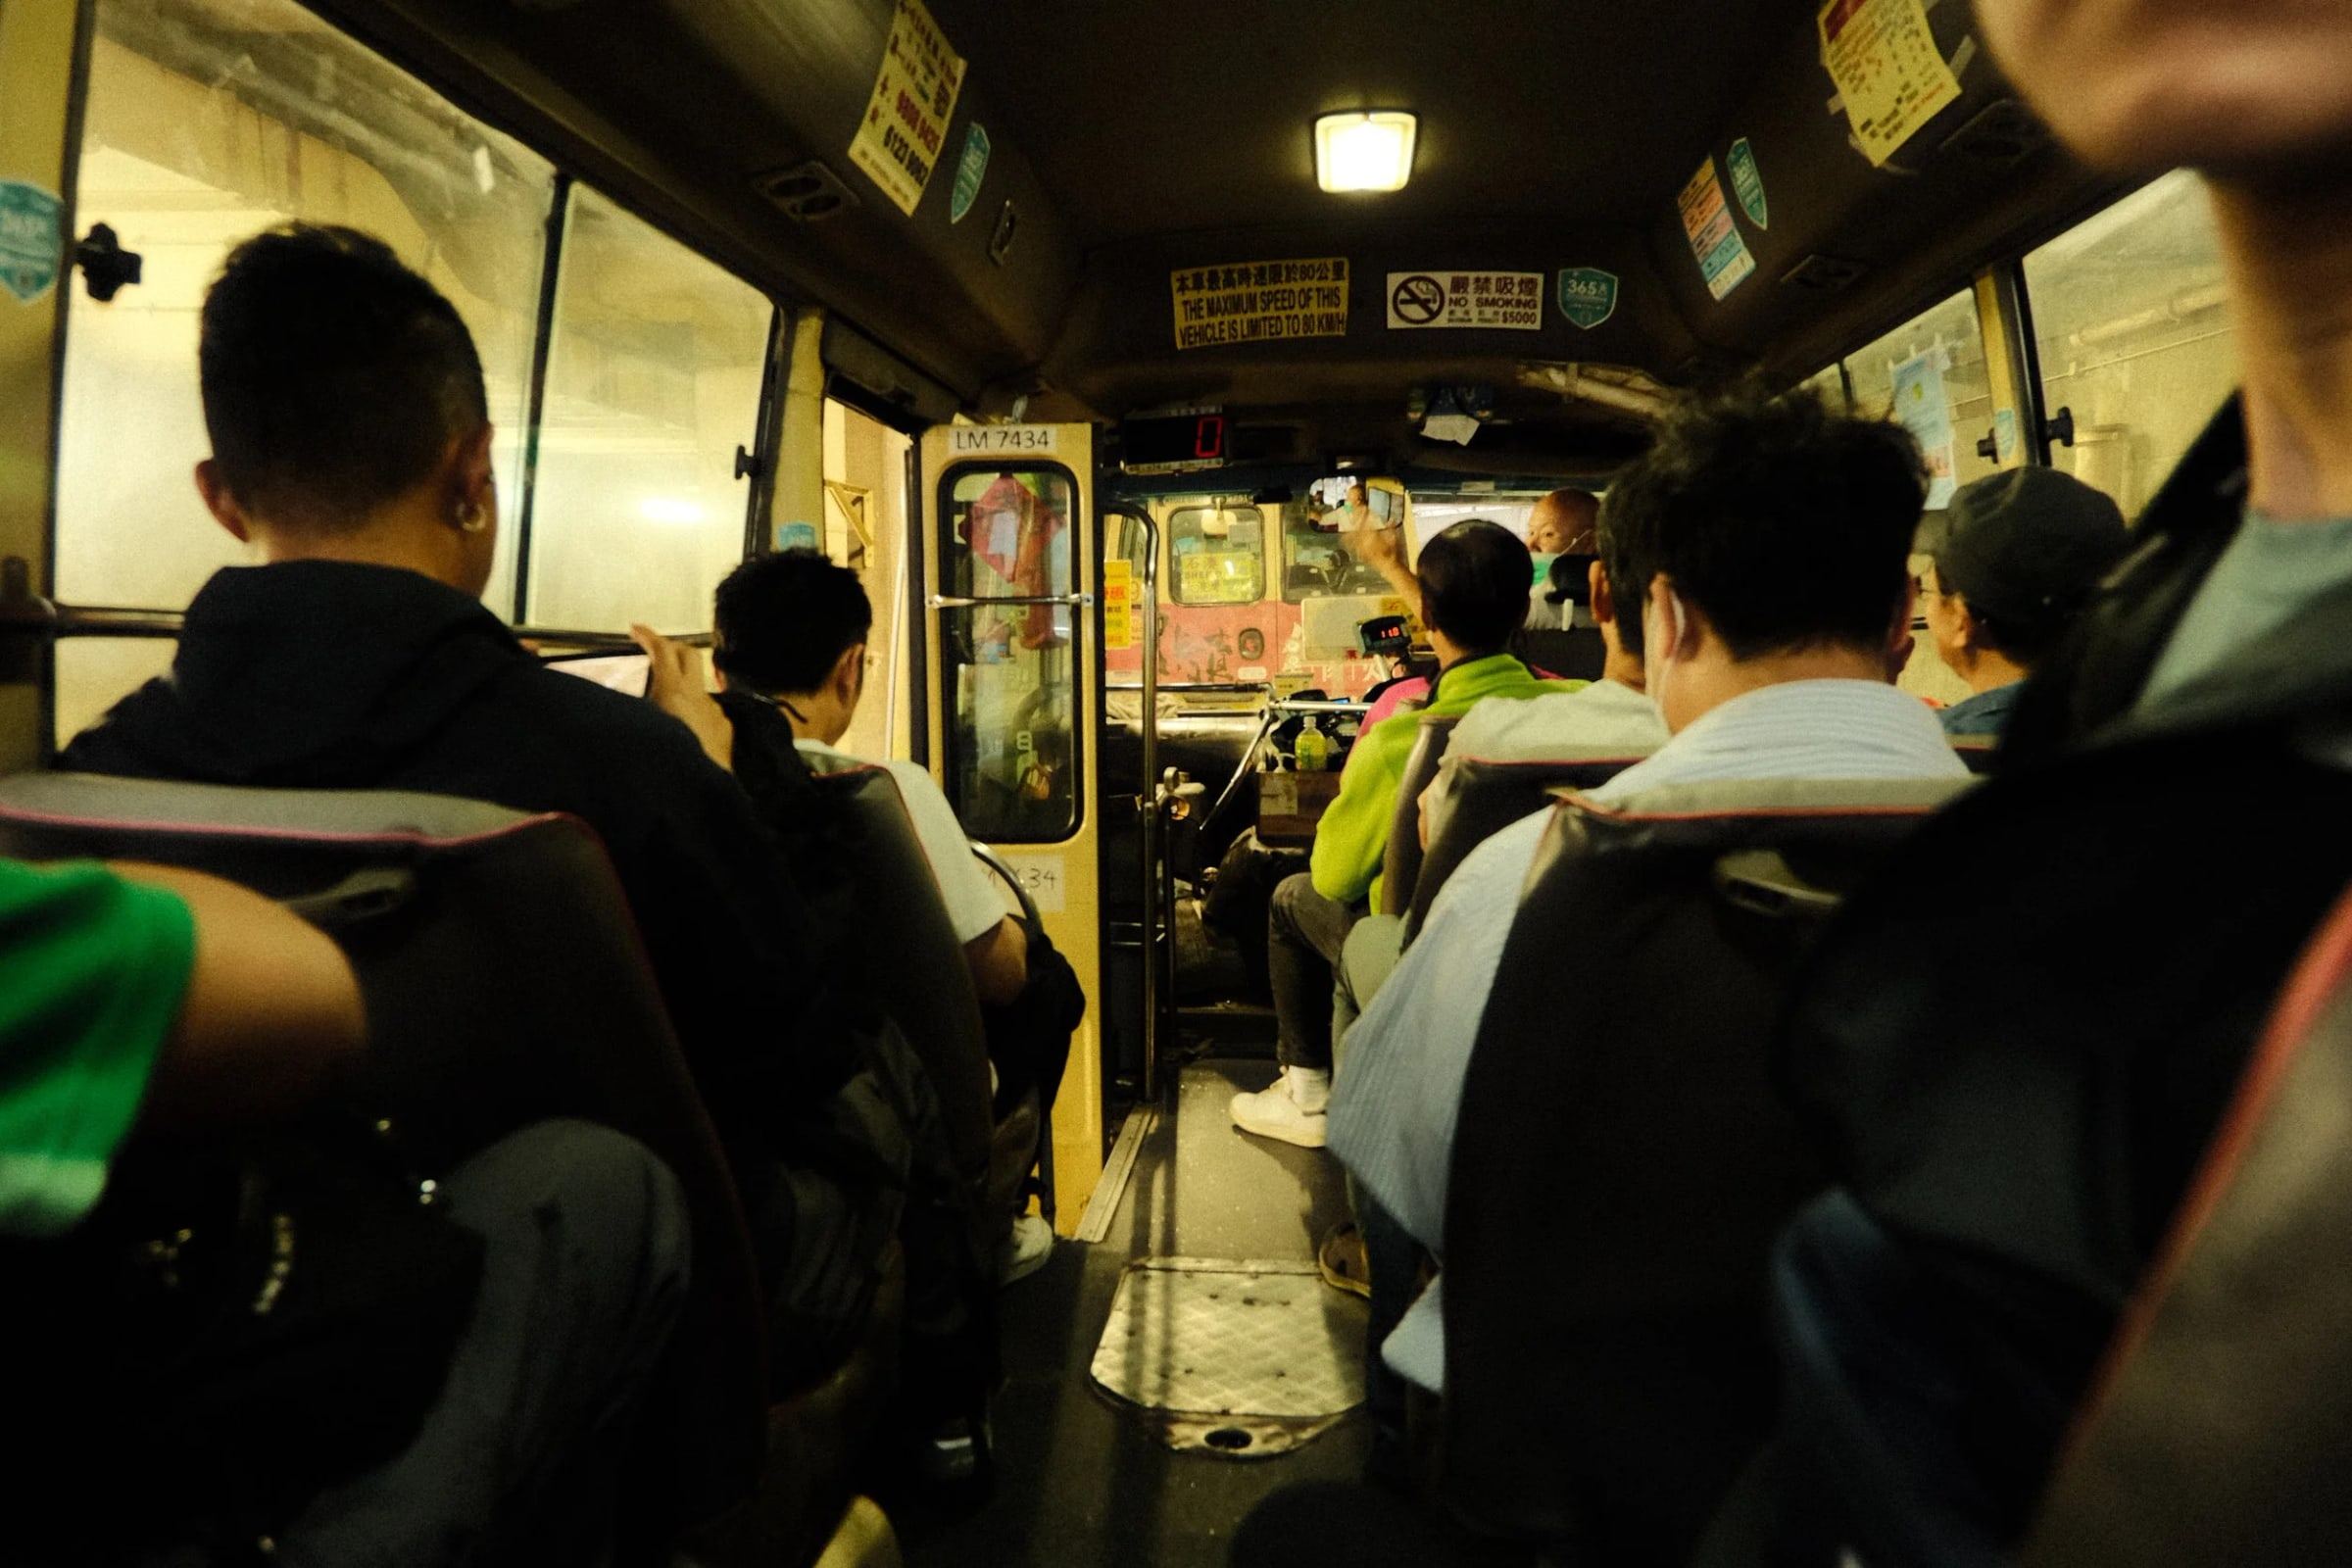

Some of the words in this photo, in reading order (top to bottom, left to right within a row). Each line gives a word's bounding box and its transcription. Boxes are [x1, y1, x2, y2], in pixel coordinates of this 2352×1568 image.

[1182, 297, 1203, 321] THE
[1206, 291, 1257, 318] MAXIMUM
[1260, 288, 1295, 312] SPEED
[1298, 287, 1313, 309] OF
[1316, 286, 1341, 309] THIS
[1449, 297, 1468, 308] NO
[1476, 297, 1537, 310] SMOKING
[1179, 320, 1225, 346] VEHICLE
[1227, 318, 1238, 340] IS
[1240, 316, 1283, 338] LIMITED
[1285, 314, 1300, 334] TO
[1302, 314, 1315, 334] 80
[1502, 311, 1537, 324] $5000
[956, 430, 988, 449] LM
[996, 430, 1049, 449] 7434
[1196, 415, 1223, 458] 0
